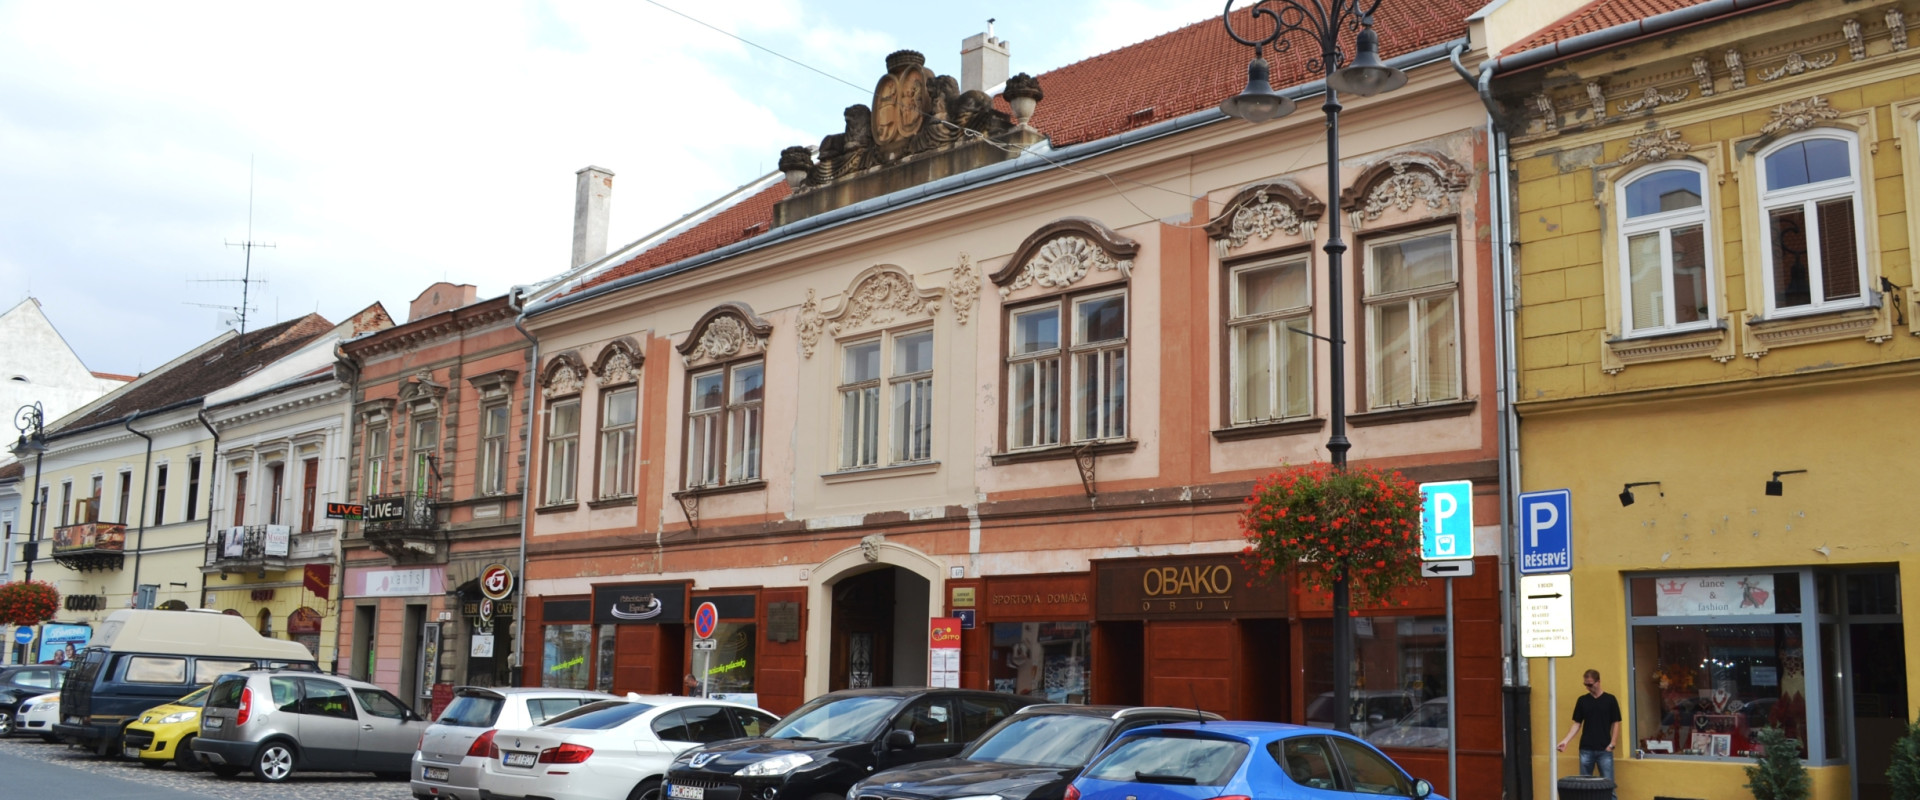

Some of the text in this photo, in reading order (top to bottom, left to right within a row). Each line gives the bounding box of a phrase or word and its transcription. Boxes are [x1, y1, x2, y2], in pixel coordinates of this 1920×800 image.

[328, 504, 362, 515] LIVE
[369, 502, 392, 518] LIVE
[1434, 492, 1458, 534] P
[1530, 501, 1559, 548] P
[1525, 548, 1567, 568] RÉSERVÉ
[1143, 565, 1232, 596] OBAKO
[1699, 580, 1725, 588] dance
[1709, 591, 1717, 599] &
[1698, 603, 1729, 611] fashion
